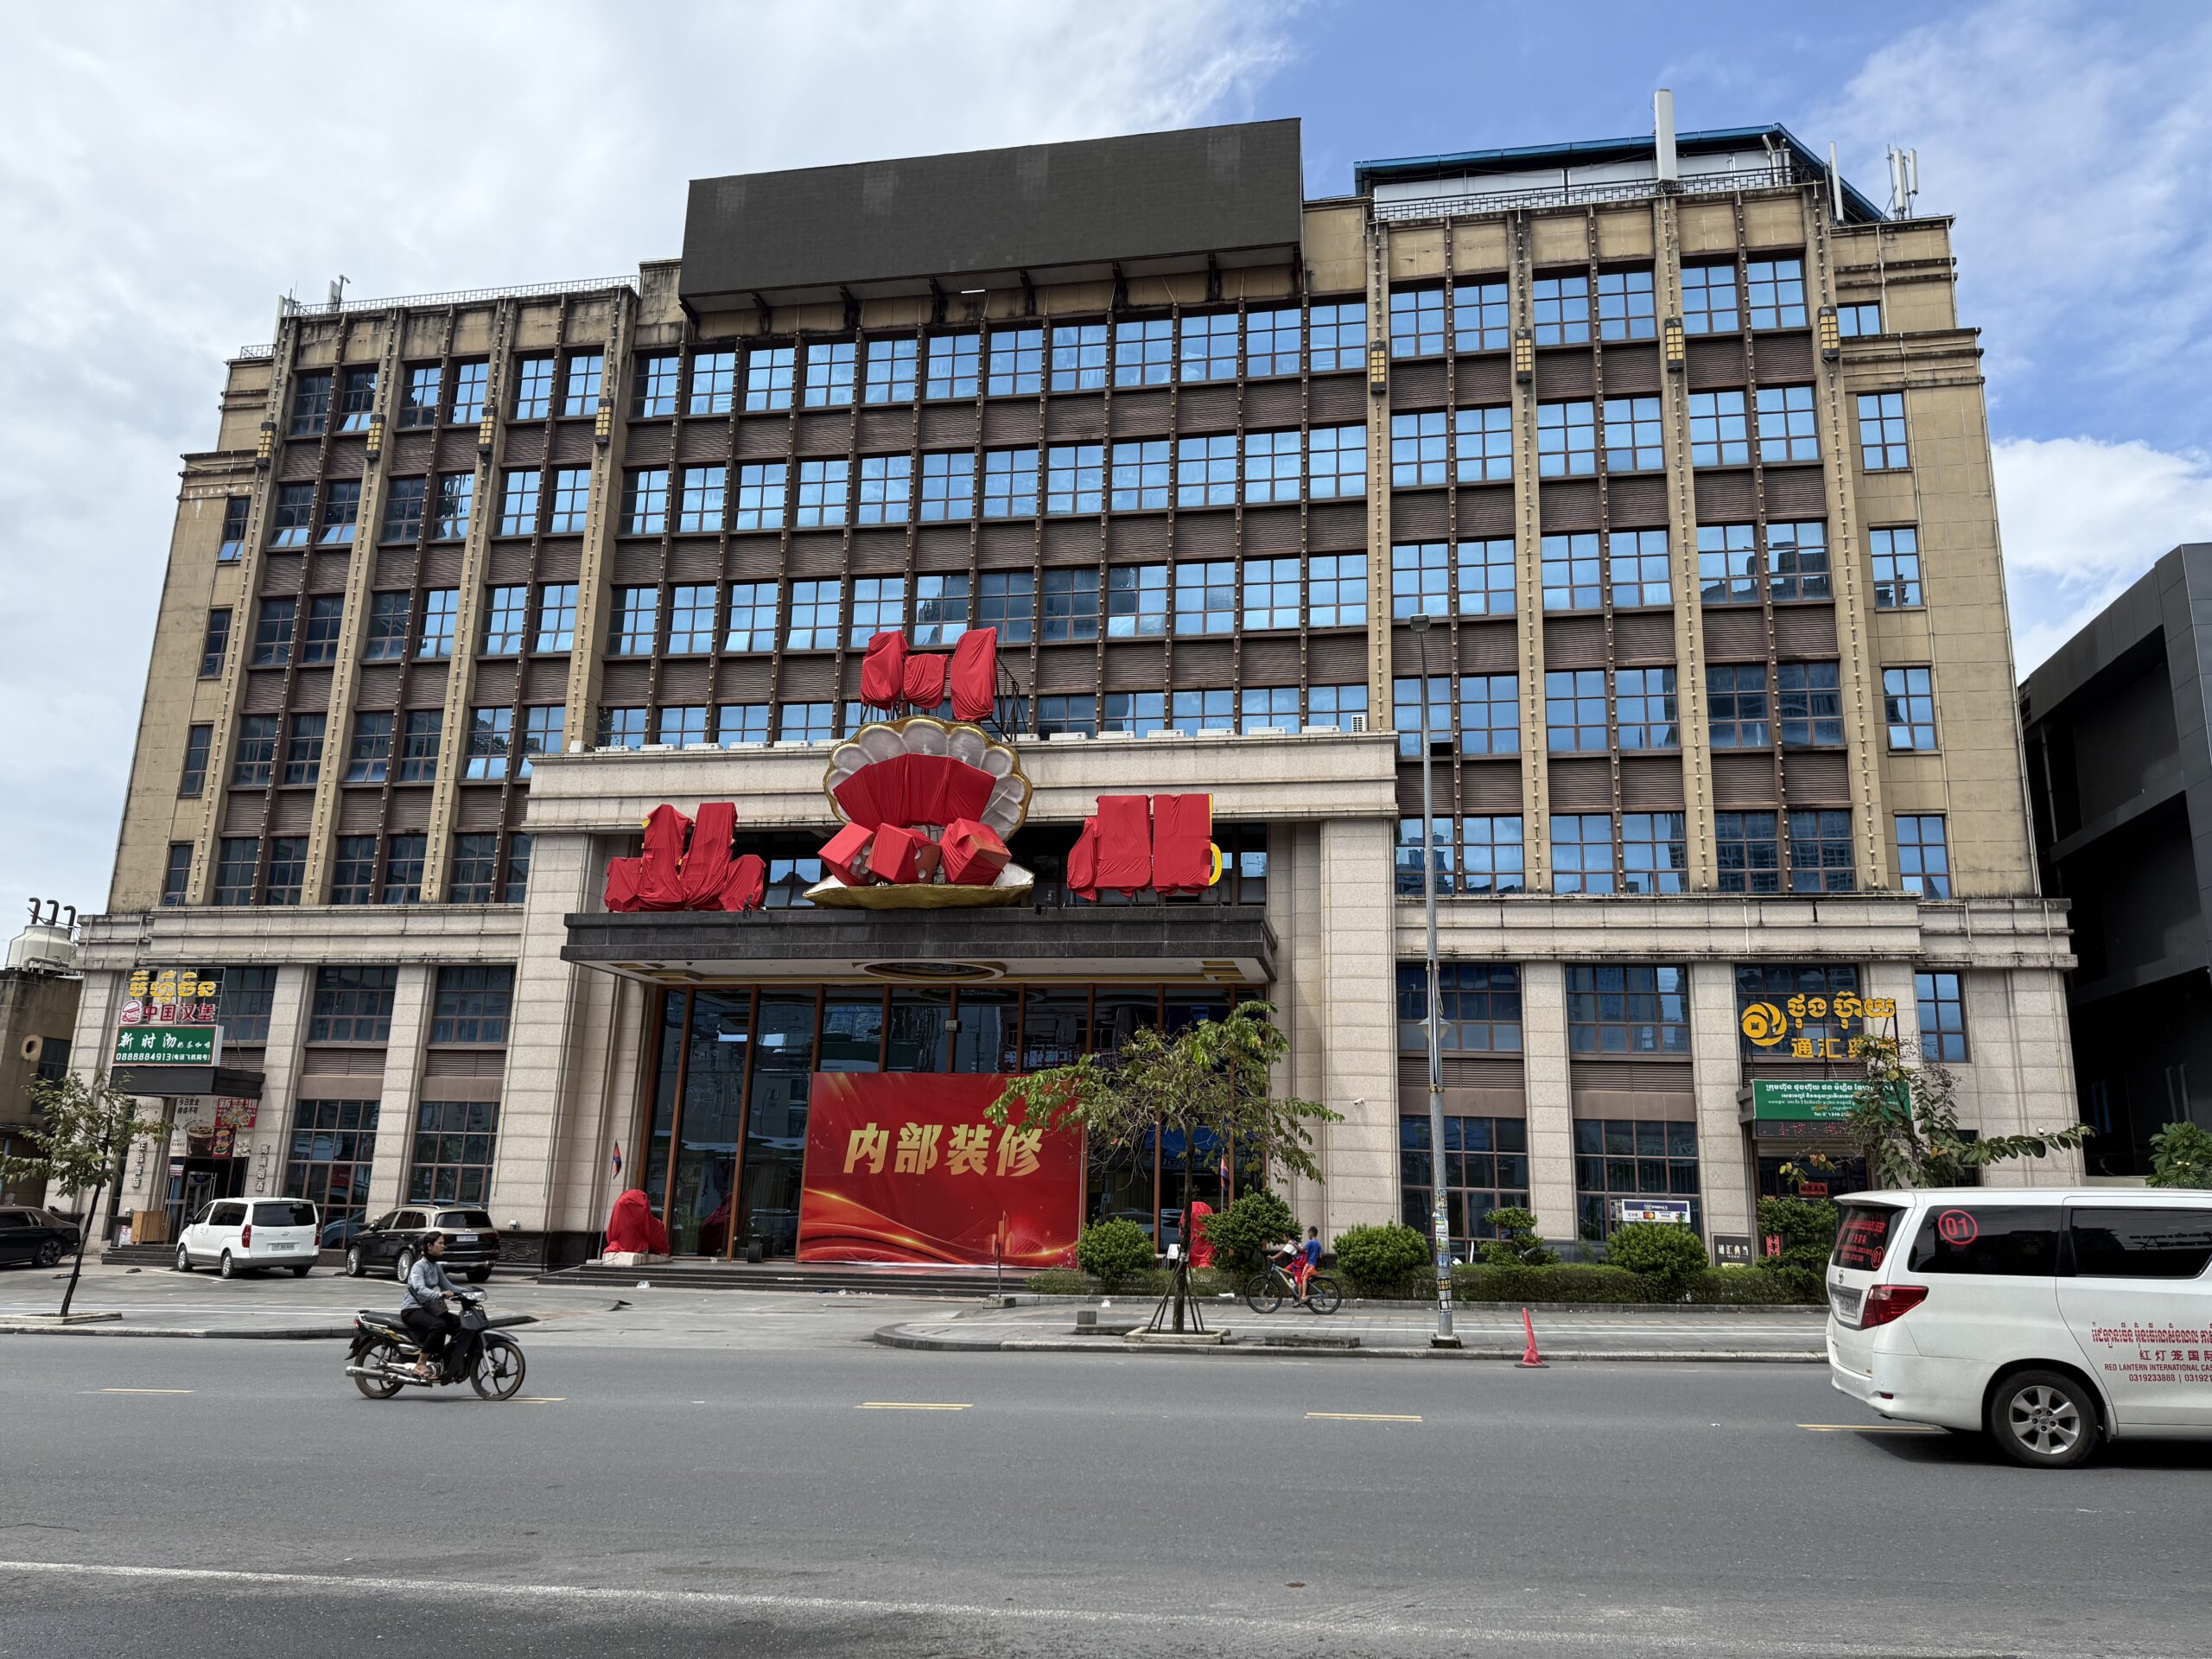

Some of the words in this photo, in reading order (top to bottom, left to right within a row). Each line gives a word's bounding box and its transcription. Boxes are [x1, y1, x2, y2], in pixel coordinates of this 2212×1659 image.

[143, 1003, 216, 1022] 中国汉堡
[842, 1122, 1044, 1177] 内部装修
[1945, 1217, 1969, 1237] 01
[1872, 1250, 1882, 1264] 01
